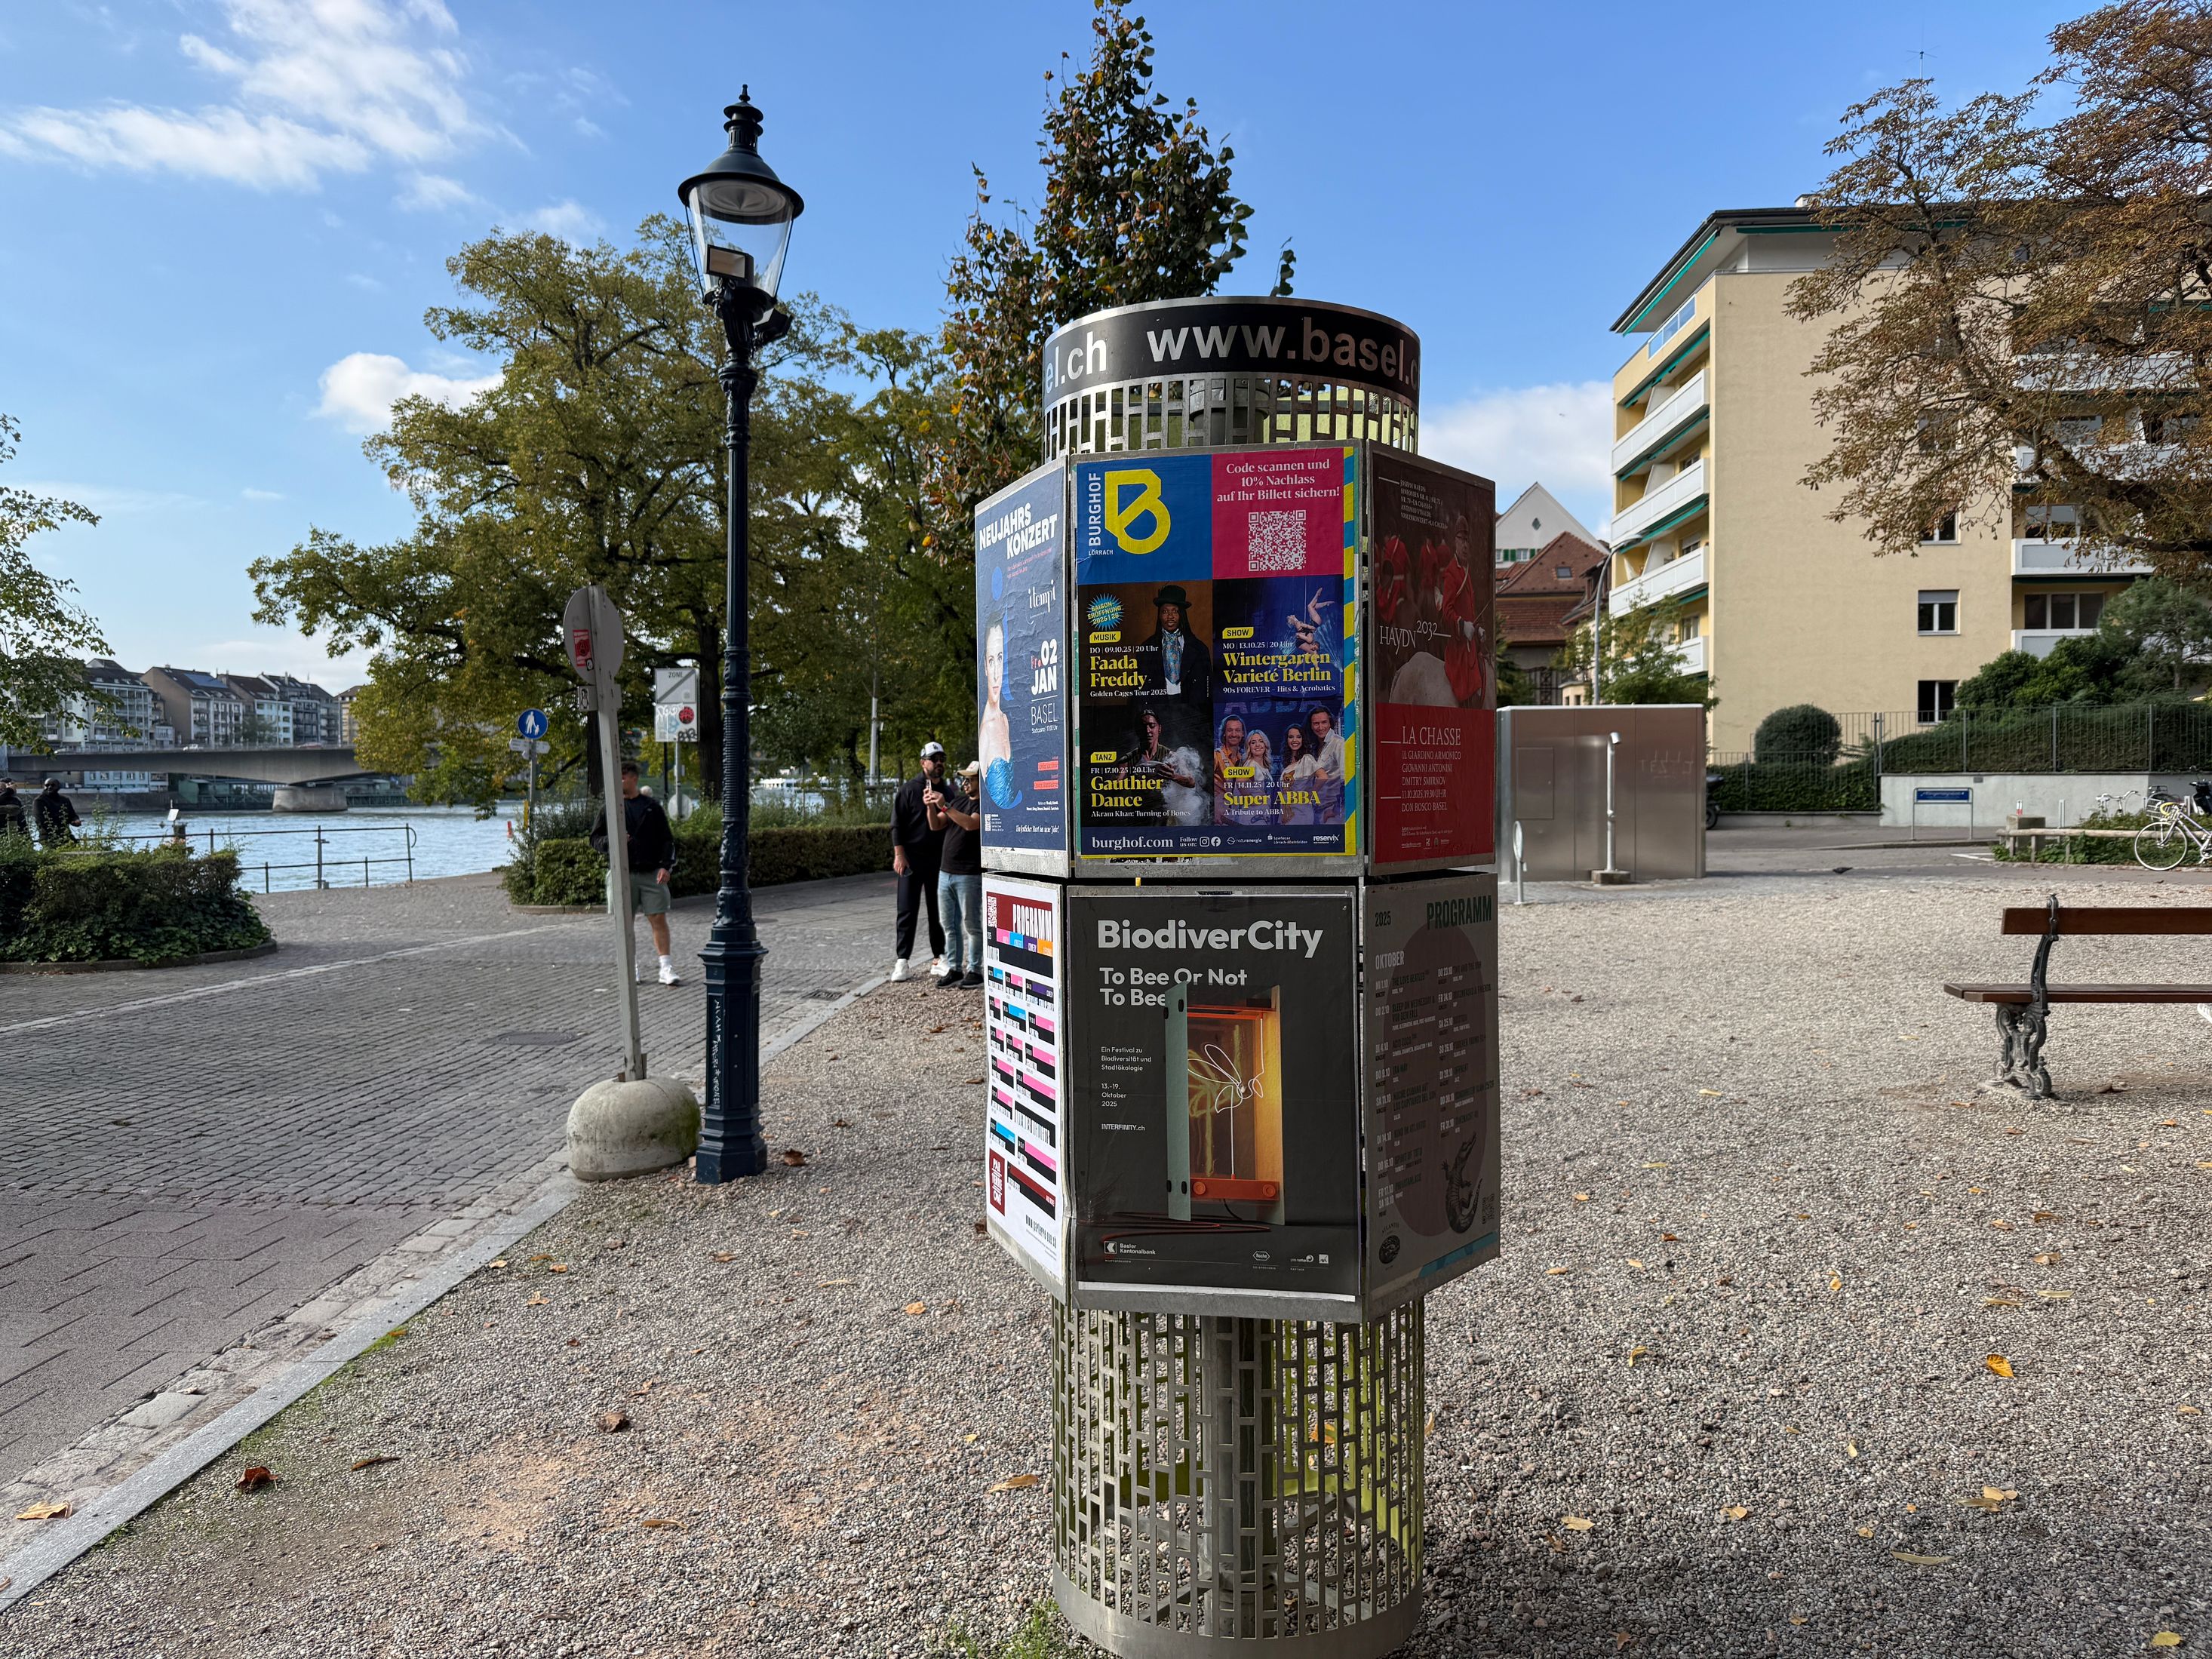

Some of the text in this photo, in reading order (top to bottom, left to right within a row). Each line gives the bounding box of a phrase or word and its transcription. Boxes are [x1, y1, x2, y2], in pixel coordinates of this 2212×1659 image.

[1226, 459, 1330, 474] Code scannen und
[1241, 473, 1316, 487] 10% Nachlass
[1217, 486, 1340, 503] auf Ihr Billett sichern!
[1088, 472, 1101, 546] BURGHOF
[979, 502, 1031, 551] NEUJAHRS
[1006, 513, 1058, 560] KONZERT
[1093, 633, 1117, 641] MUSIK
[1227, 628, 1249, 637] SHOW
[1379, 620, 1438, 655] HAYDN 2032
[1041, 638, 1058, 666] 02
[1223, 651, 1330, 668] Wintergarten
[1090, 654, 1138, 670] Faada
[1031, 665, 1057, 696] JAN
[1090, 671, 1147, 690] Freddy
[1223, 667, 1332, 684] Varieté Berlin
[1299, 684, 1336, 693] Acrobatics
[1031, 702, 1058, 726] BASEL
[1402, 726, 1461, 745] LA CHASSE
[1402, 750, 1461, 760] IL GIARDINO ARMONICO
[1402, 763, 1453, 773] GIOVANNI ANTONINI
[1090, 775, 1164, 791] Gauthier
[1402, 776, 1446, 786] DMITRY SMIRNOV
[1090, 793, 1143, 807] Dance
[1224, 791, 1321, 809] Super ABBA
[1435, 789, 1447, 797] UHR
[1402, 801, 1448, 812] DON BOSCO BASEL
[1092, 836, 1174, 851] burghof.com
[1313, 834, 1341, 843] reservix
[1375, 911, 1392, 927] 2025
[1427, 895, 1492, 930] PROGRAMM
[1012, 903, 1052, 942] PROGRAMM
[1097, 919, 1323, 958] BiodiverCity
[1375, 950, 1405, 970] OKTOBER
[1099, 967, 1248, 986] To Bee Or Not
[1099, 988, 1126, 1006] To
[1101, 1065, 1143, 1073] Stadtökologie
[1101, 1123, 1145, 1132] INTERFINITY.ch
